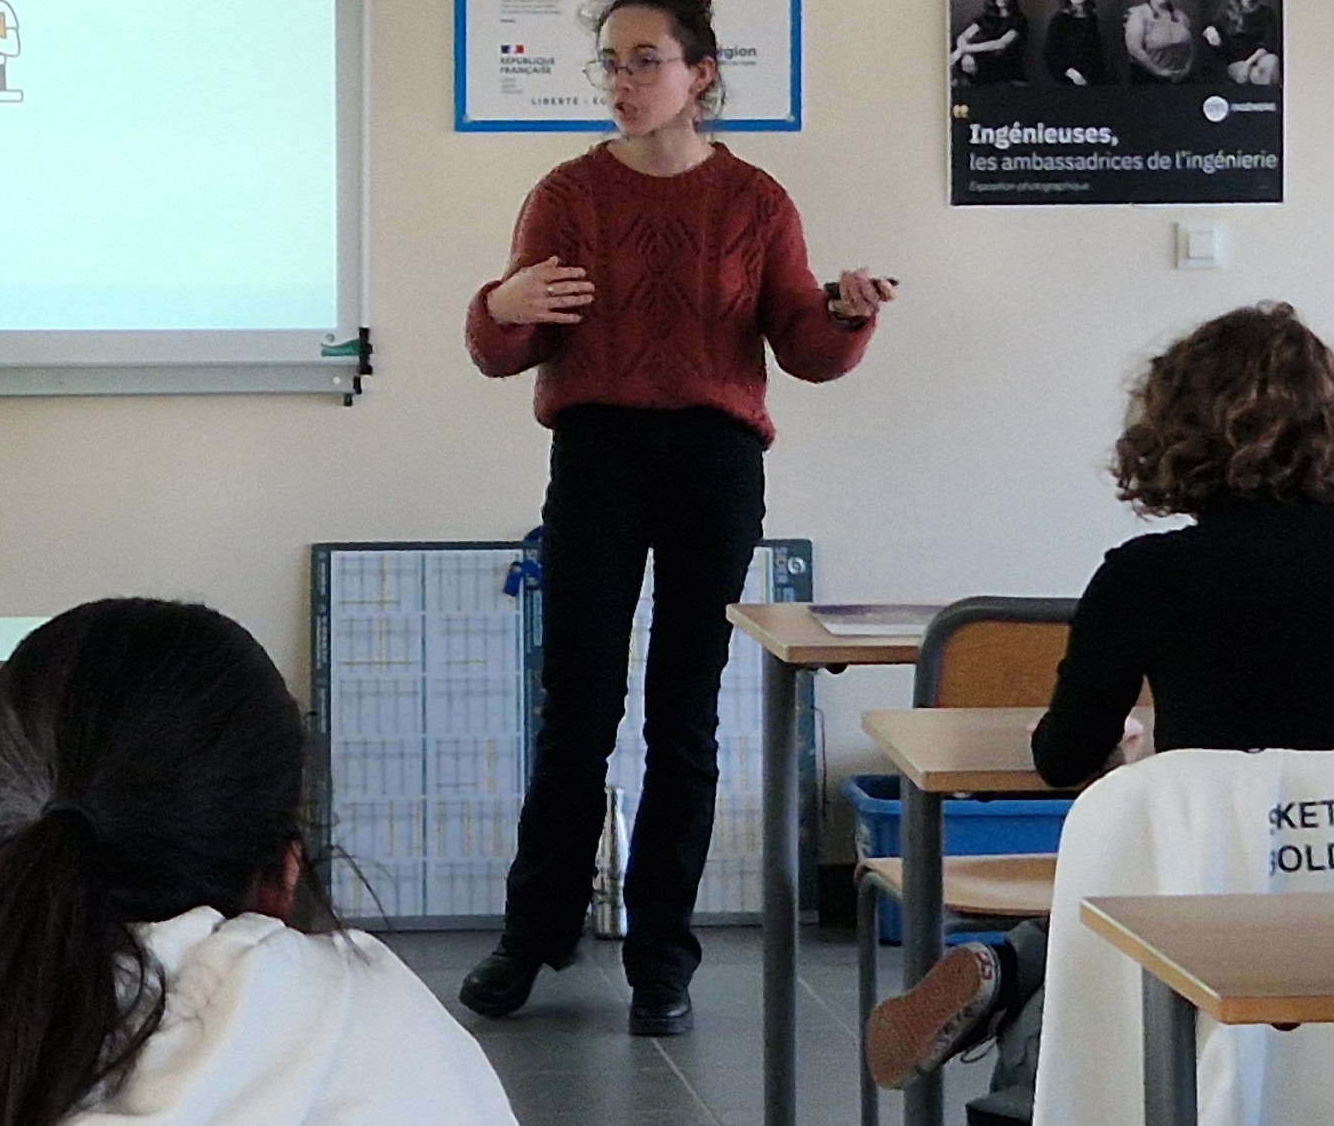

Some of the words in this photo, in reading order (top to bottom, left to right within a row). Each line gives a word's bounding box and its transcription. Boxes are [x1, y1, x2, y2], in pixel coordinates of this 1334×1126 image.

[717, 44, 757, 60] gion
[970, 121, 1119, 149] Ingénieuses,
[970, 152, 997, 171] les
[1001, 152, 1144, 171] ambassadrices
[1147, 151, 1172, 171] de
[1175, 149, 1278, 174] l'ingénierie
